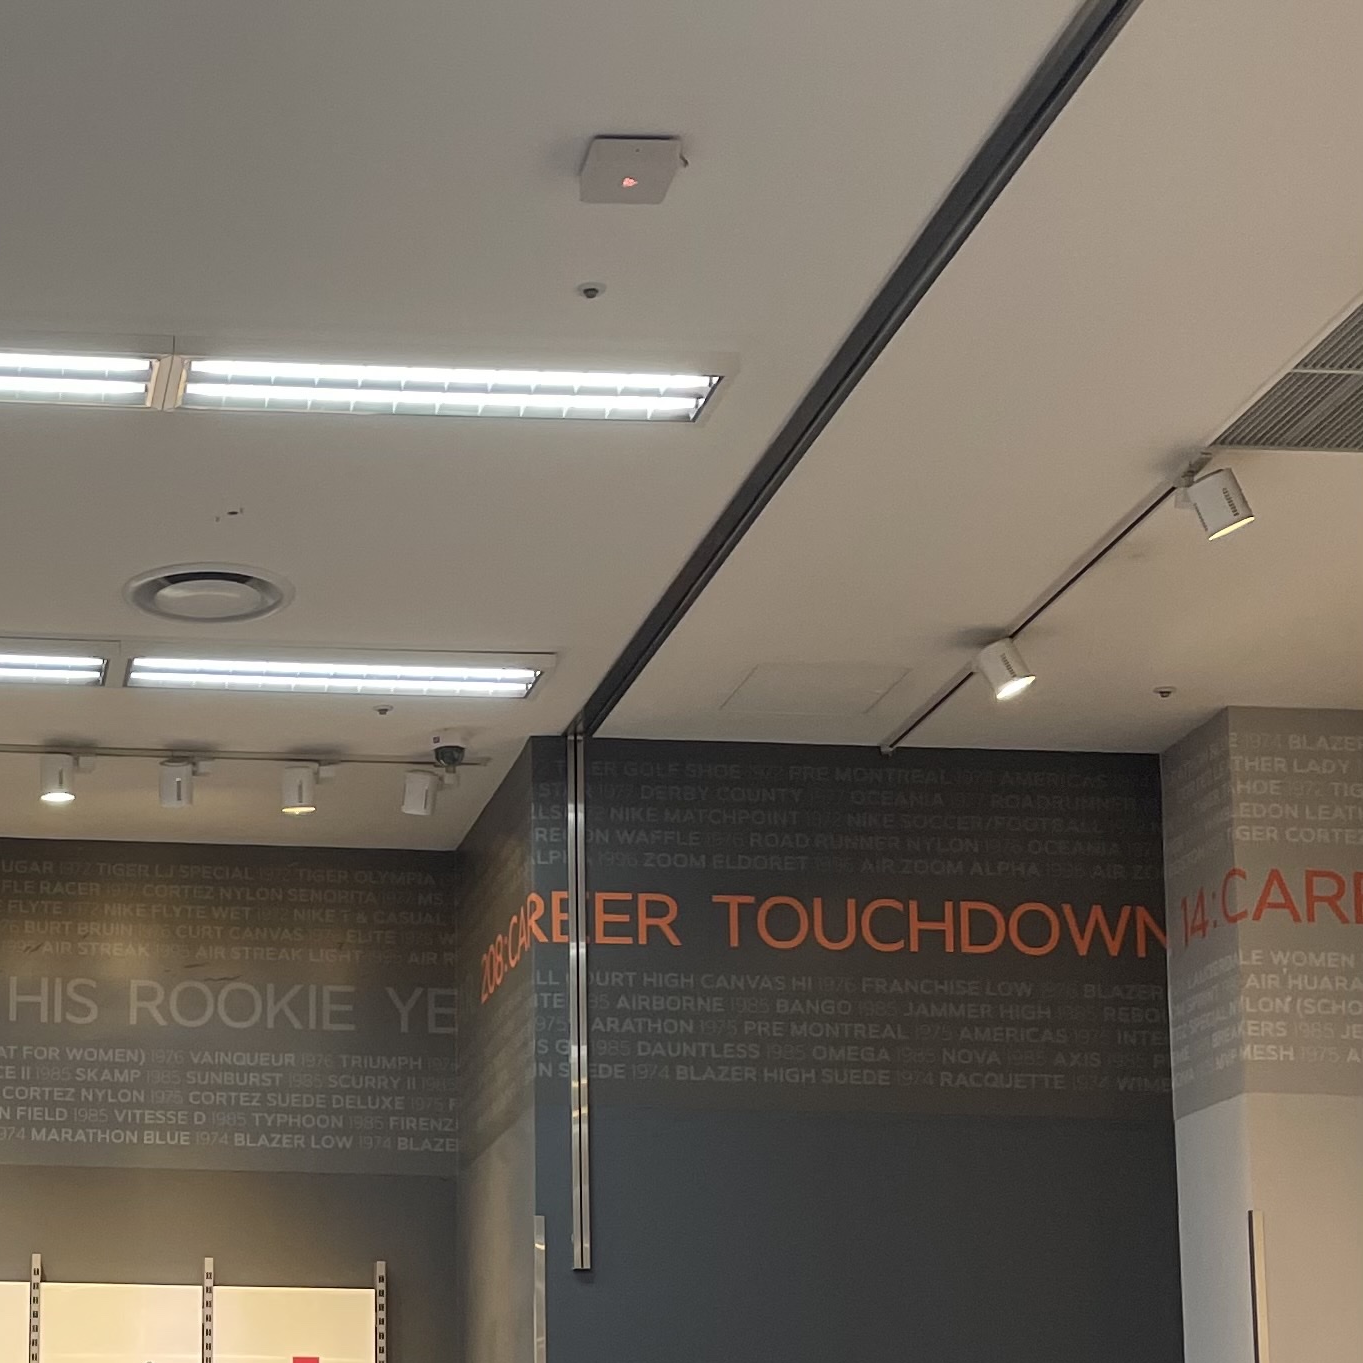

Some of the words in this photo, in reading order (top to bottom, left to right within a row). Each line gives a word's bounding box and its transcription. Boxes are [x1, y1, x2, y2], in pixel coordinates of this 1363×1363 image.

[1180, 867, 1363, 947] 14:CAR
[711, 892, 1168, 958] TOUCHDOWN
[7, 976, 99, 1025] HIS
[128, 977, 357, 1031] ROOKIE
[616, 993, 726, 1013] AIRBORNE
[591, 1017, 694, 1035] ARATHON
[22, 1046, 61, 1061] FOR
[65, 1047, 146, 1063] WOMEN)
[338, 1054, 423, 1071] TRIUMPH
[636, 1040, 761, 1059] DAUNTLESS
[74, 1067, 142, 1083] SKAMP
[185, 1070, 283, 1087] SUNBURST
[327, 1074, 402, 1090] SCURRY
[674, 1064, 758, 1083] BLAZER
[762, 1067, 816, 1083] HIGH
[821, 1067, 892, 1086] SUEDE
[1, 1085, 76, 1102] CORTEZ
[79, 1088, 145, 1104] NYLON
[188, 1090, 262, 1107] CORTEZ
[266, 1092, 327, 1109] SUEDE
[331, 1094, 406, 1111] DELUXE
[15, 1106, 69, 1121] FIELD
[113, 1109, 188, 1125] VITESSE
[250, 1112, 344, 1129] TYPHOON
[388, 1116, 459, 1132] FIRENZ
[30, 1127, 139, 1145] MARATHON
[143, 1130, 191, 1146] BLUE
[233, 1132, 306, 1149] BLAZER
[310, 1135, 354, 1149] LOW
